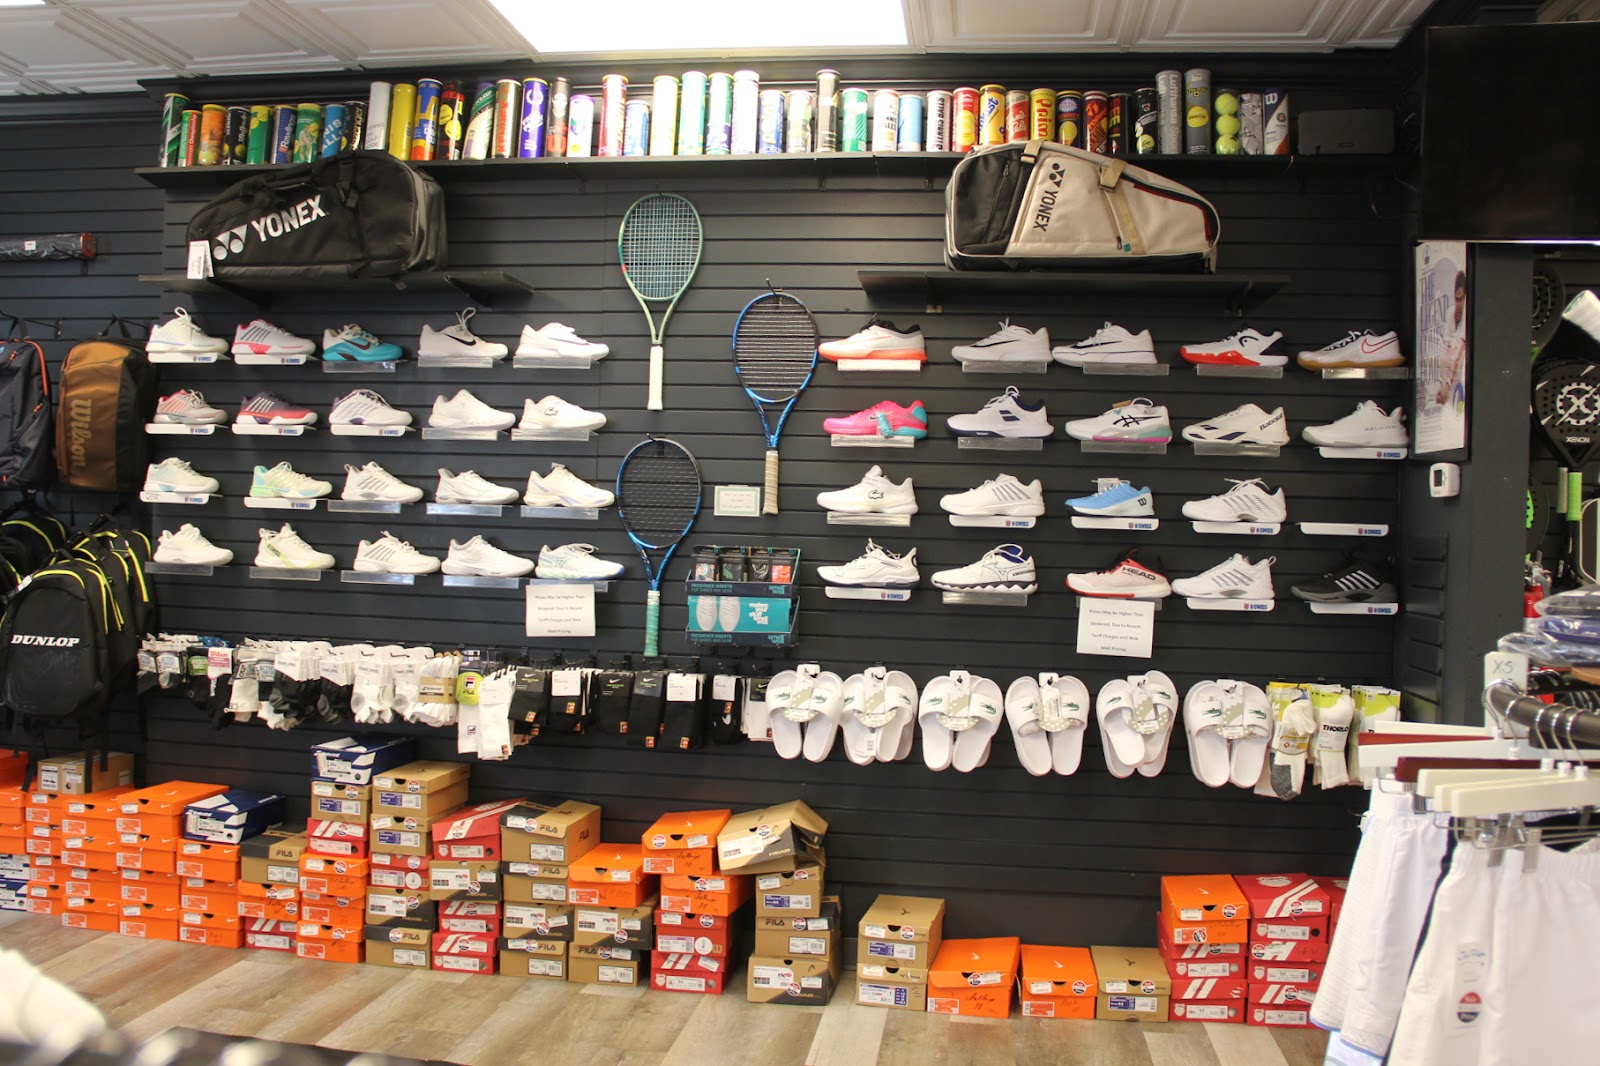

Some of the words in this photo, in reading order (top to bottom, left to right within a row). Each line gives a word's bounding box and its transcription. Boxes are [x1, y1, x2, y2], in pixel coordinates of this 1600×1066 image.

[1170, 74, 1178, 124] Lufthansa
[281, 114, 296, 148] Rawlings
[324, 119, 342, 138] NIS
[498, 101, 508, 152] KENNEX
[1036, 99, 1052, 137] Prim
[250, 194, 327, 242] YONEX
[1033, 190, 1058, 232] YONEX
[70, 399, 92, 468] Wilson
[1260, 413, 1283, 430] Babolat
[1121, 566, 1156, 581] HEAD
[10, 634, 80, 648] DUNLOP
[1492, 660, 1514, 674] XS
[540, 824, 558, 833] FILA
[579, 829, 590, 842] FILA
